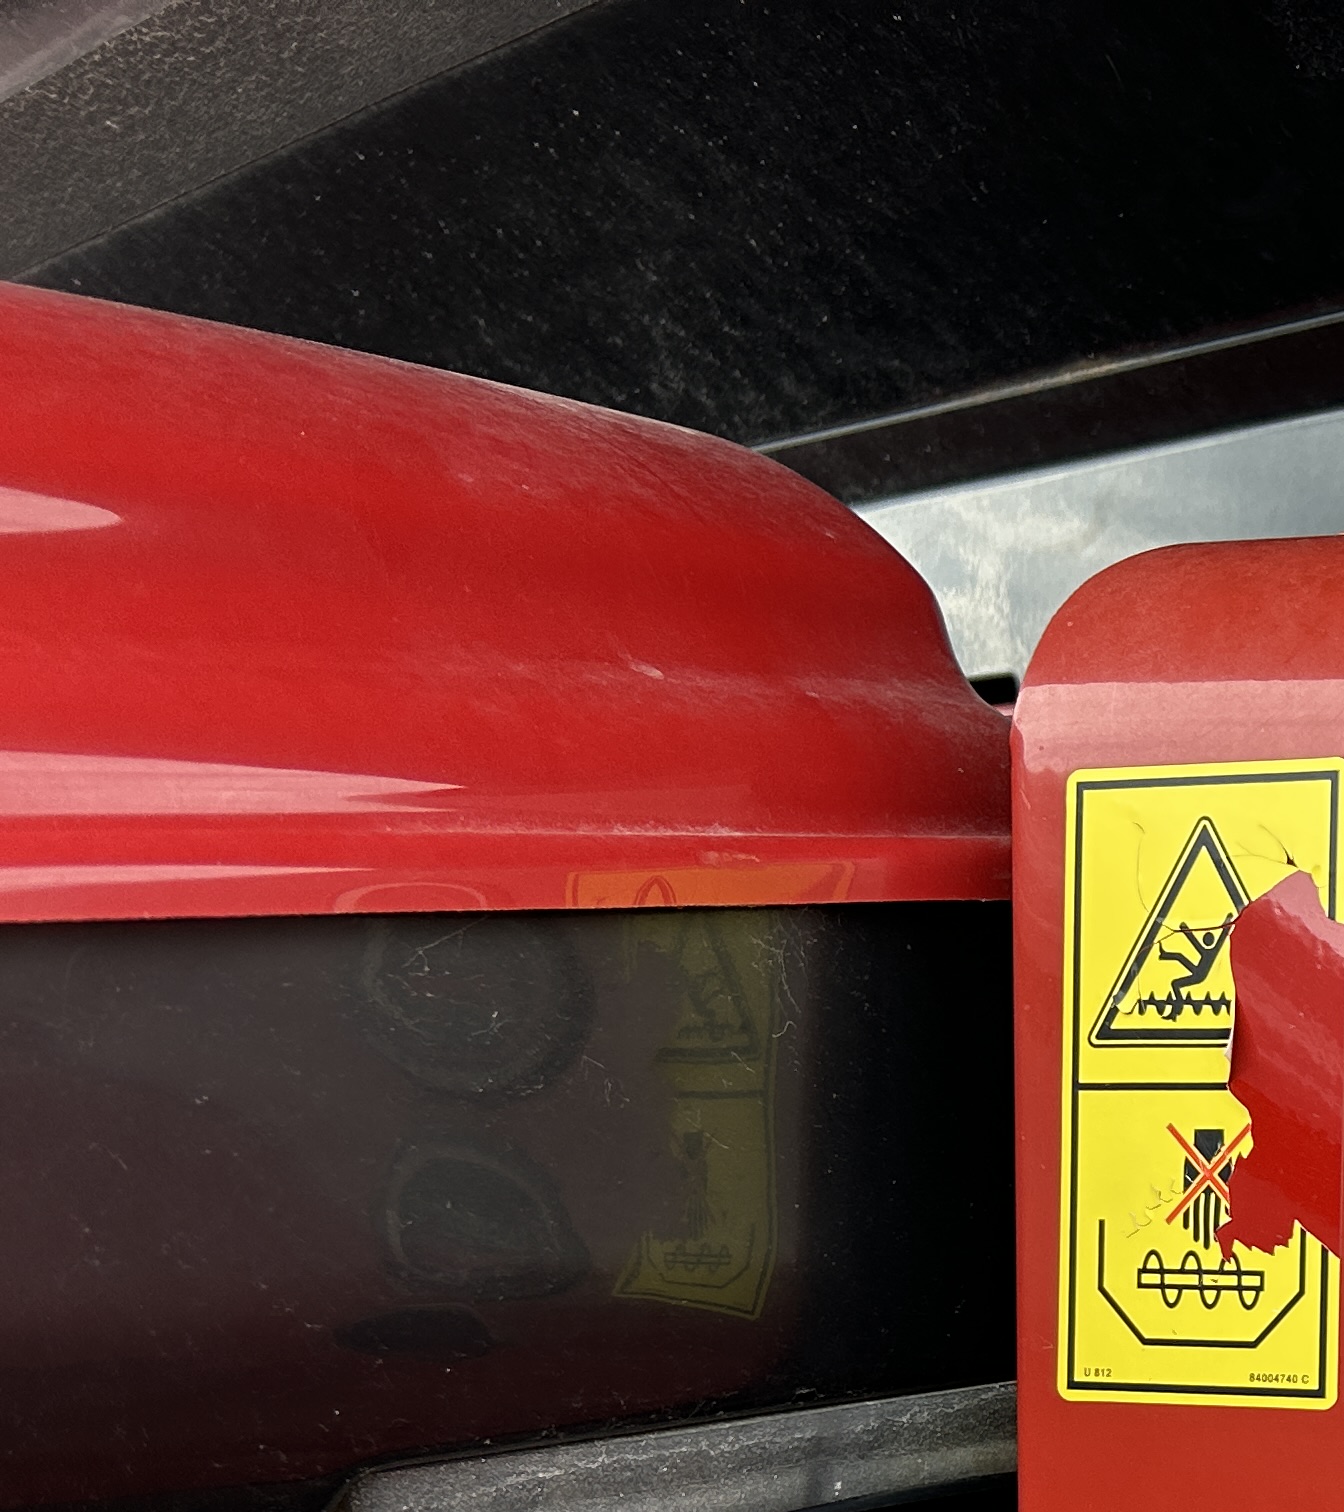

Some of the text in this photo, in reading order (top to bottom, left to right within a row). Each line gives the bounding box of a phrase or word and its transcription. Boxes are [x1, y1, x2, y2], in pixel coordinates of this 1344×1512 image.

[1084, 1367, 1112, 1378] U 812
[1301, 1374, 1310, 1385] C
